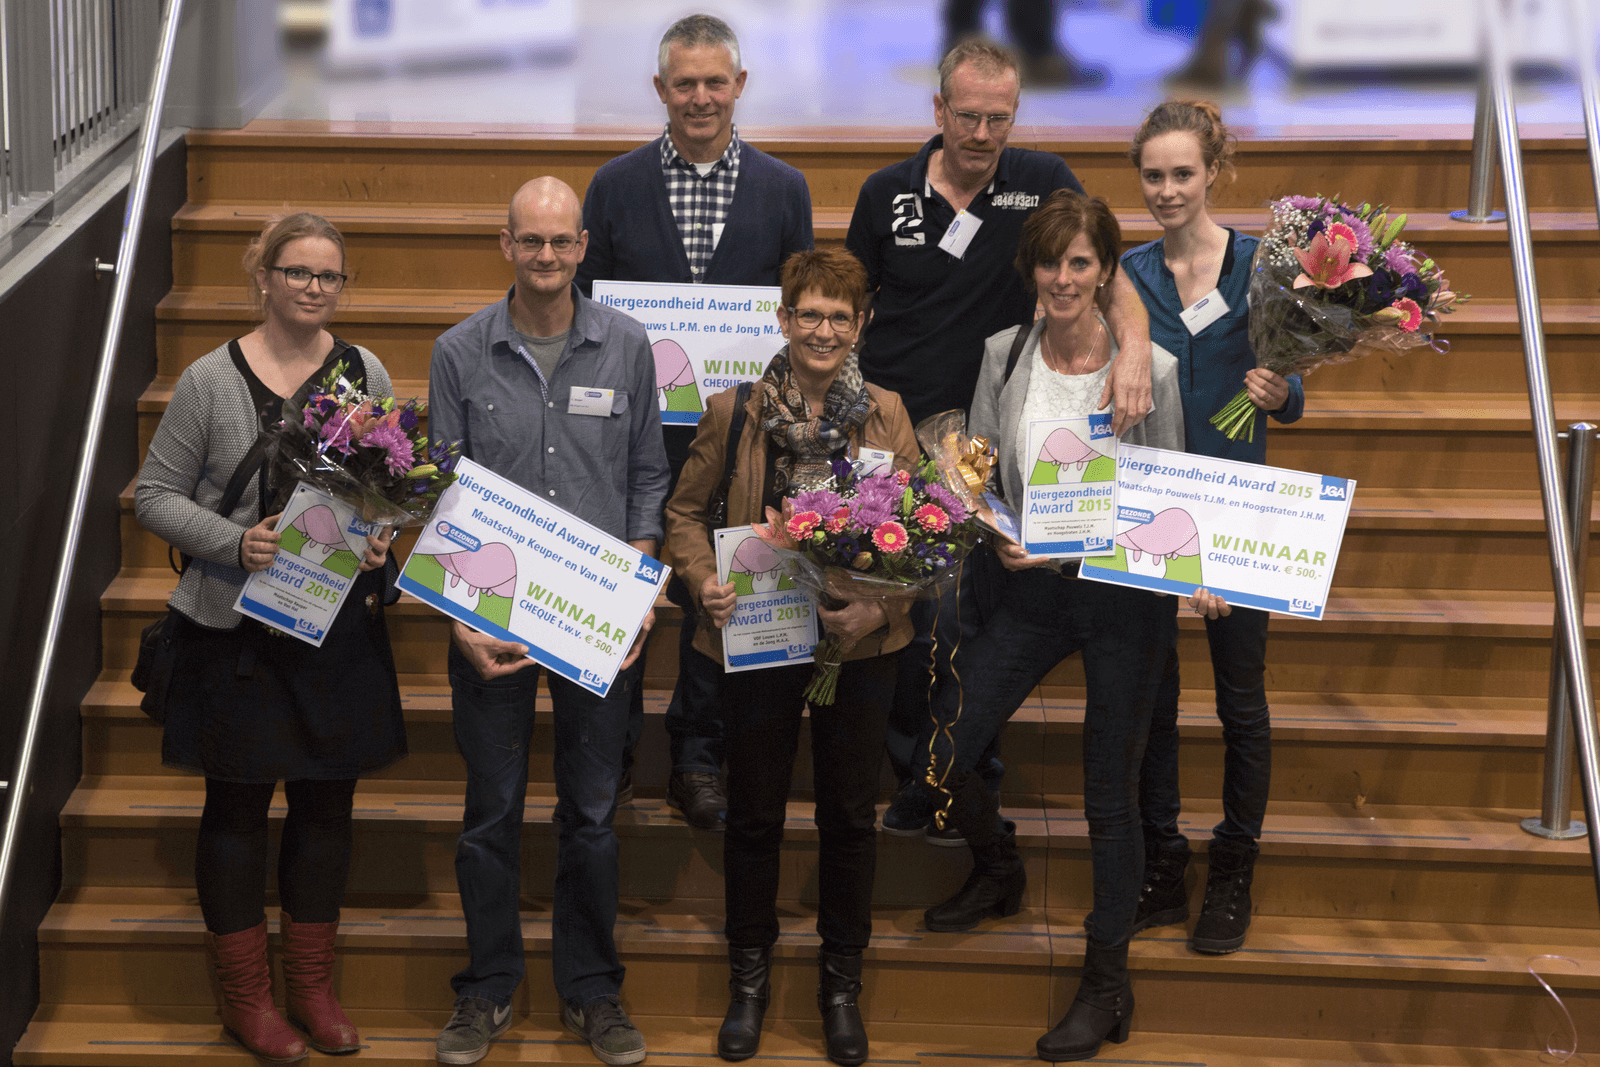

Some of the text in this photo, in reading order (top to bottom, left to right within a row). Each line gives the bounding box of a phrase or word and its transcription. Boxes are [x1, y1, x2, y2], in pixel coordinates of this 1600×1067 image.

[892, 193, 925, 246] 2
[600, 294, 782, 312] Uiergezondheid Award 201
[670, 322, 700, 332] L.P.M.
[720, 323, 732, 333] de
[736, 324, 760, 336] Jong
[1030, 486, 1112, 501] Uiergezondheid
[1118, 457, 1313, 498] Uiergezondheid Award 2015
[1029, 498, 1111, 514] Award 2015
[1118, 481, 1163, 495] Maatschap
[1165, 488, 1201, 501] Pouwels
[1204, 494, 1226, 505] T.J.M.
[1242, 501, 1297, 517] Hoogstraten
[1300, 510, 1326, 522] J.H.M.
[459, 473, 632, 573] Uiergezondheid Award 2015
[471, 508, 525, 544] Maatschap
[527, 538, 563, 563] Keuper
[565, 559, 577, 571] en
[580, 565, 598, 582] Van
[599, 577, 618, 592] Hal
[1208, 552, 1322, 580] CHEQUE t.w.v. € 500,-
[1213, 533, 1326, 566] WINNAAR
[274, 552, 346, 591] iergezondheid
[305, 581, 340, 604] 2015
[519, 599, 616, 657] CHEQUE t.w.v. € 500,-
[527, 581, 626, 645] WINNAAR
[728, 605, 810, 627] Award 2015
